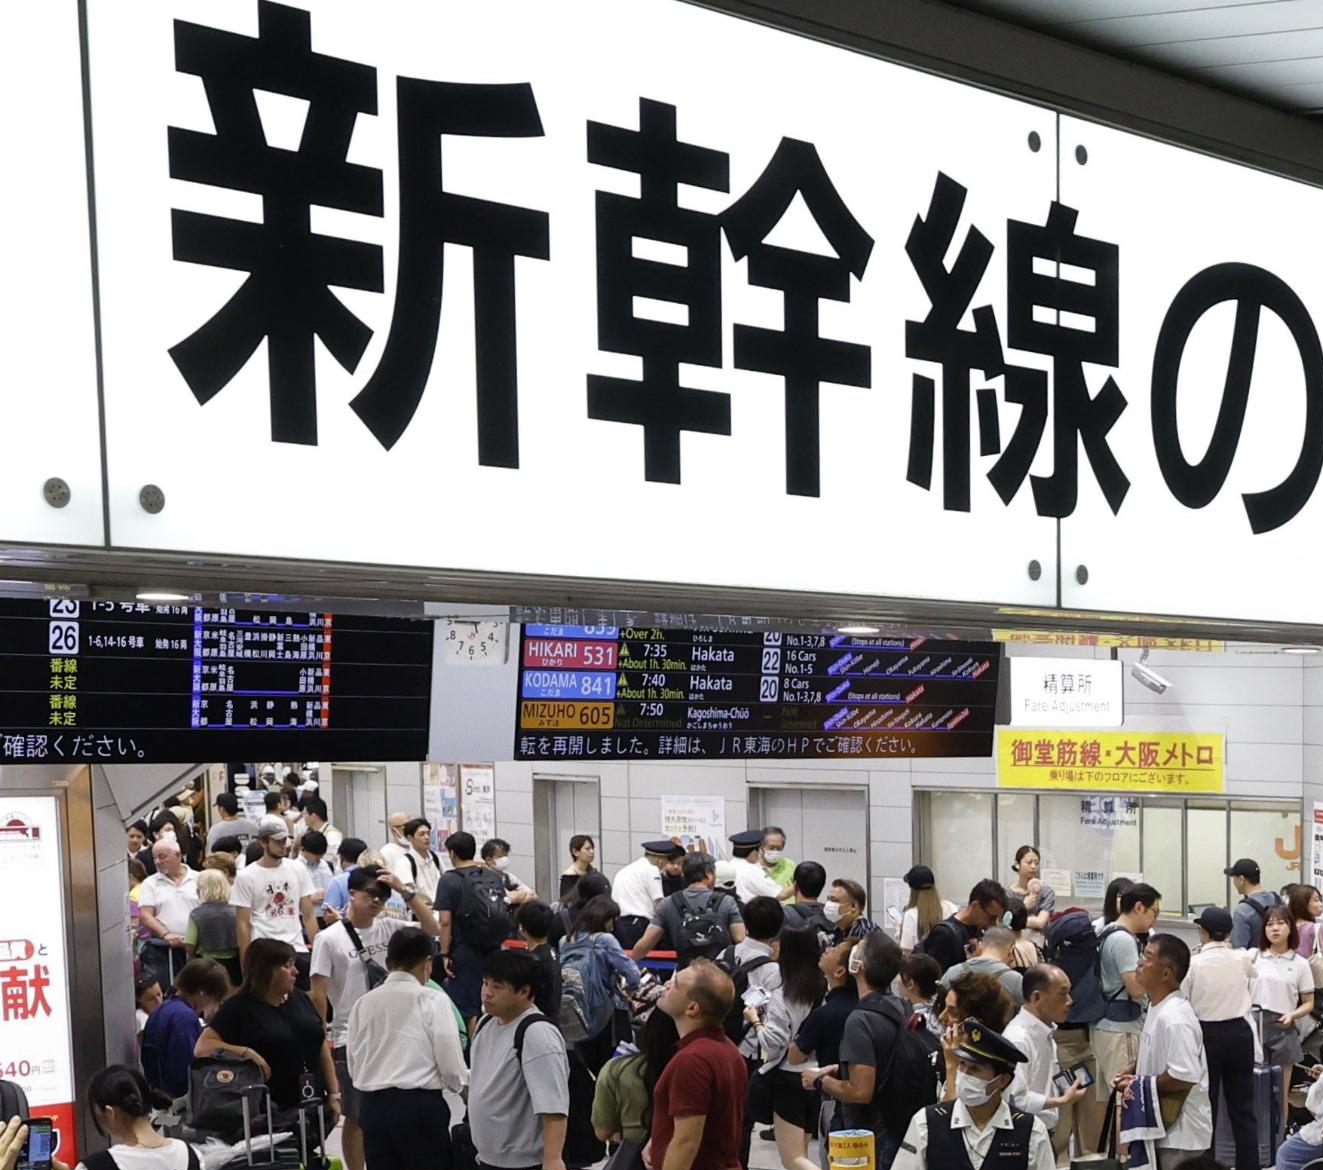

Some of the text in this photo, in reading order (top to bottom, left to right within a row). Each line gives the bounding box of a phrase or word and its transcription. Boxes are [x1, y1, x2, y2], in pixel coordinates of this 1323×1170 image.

[52, 625, 77, 651] 26
[529, 642, 613, 665] HIKARI 531
[643, 643, 667, 657] 7:35
[691, 646, 735, 662] Hakata
[787, 650, 817, 662] 16 Cars
[50, 657, 78, 673] 番線
[764, 651, 779, 670] 22
[50, 675, 77, 690] 未定
[524, 672, 611, 696] KODAMA 841
[642, 673, 665, 687] 7:40
[690, 675, 733, 691] Hakata
[783, 678, 809, 690] 8 Cars
[1043, 672, 1093, 696] 精算所
[761, 680, 778, 699] 20
[49, 695, 77, 710] 番線
[640, 702, 663, 716] 7:50
[1024, 699, 1111, 714] Fare Adjustment
[49, 712, 77, 727] 未定
[523, 703, 611, 725] MIZUHO 605
[0, 734, 145, 759] 確認ください。
[1011, 738, 1215, 768] 御堂筋線・大阪メトロ
[1049, 770, 1191, 786] 乗り場は下のフロアにございます。
[1080, 816, 1138, 829] Fare Adjustment
[38, 943, 48, 956] と
[348, 940, 389, 959] GESS
